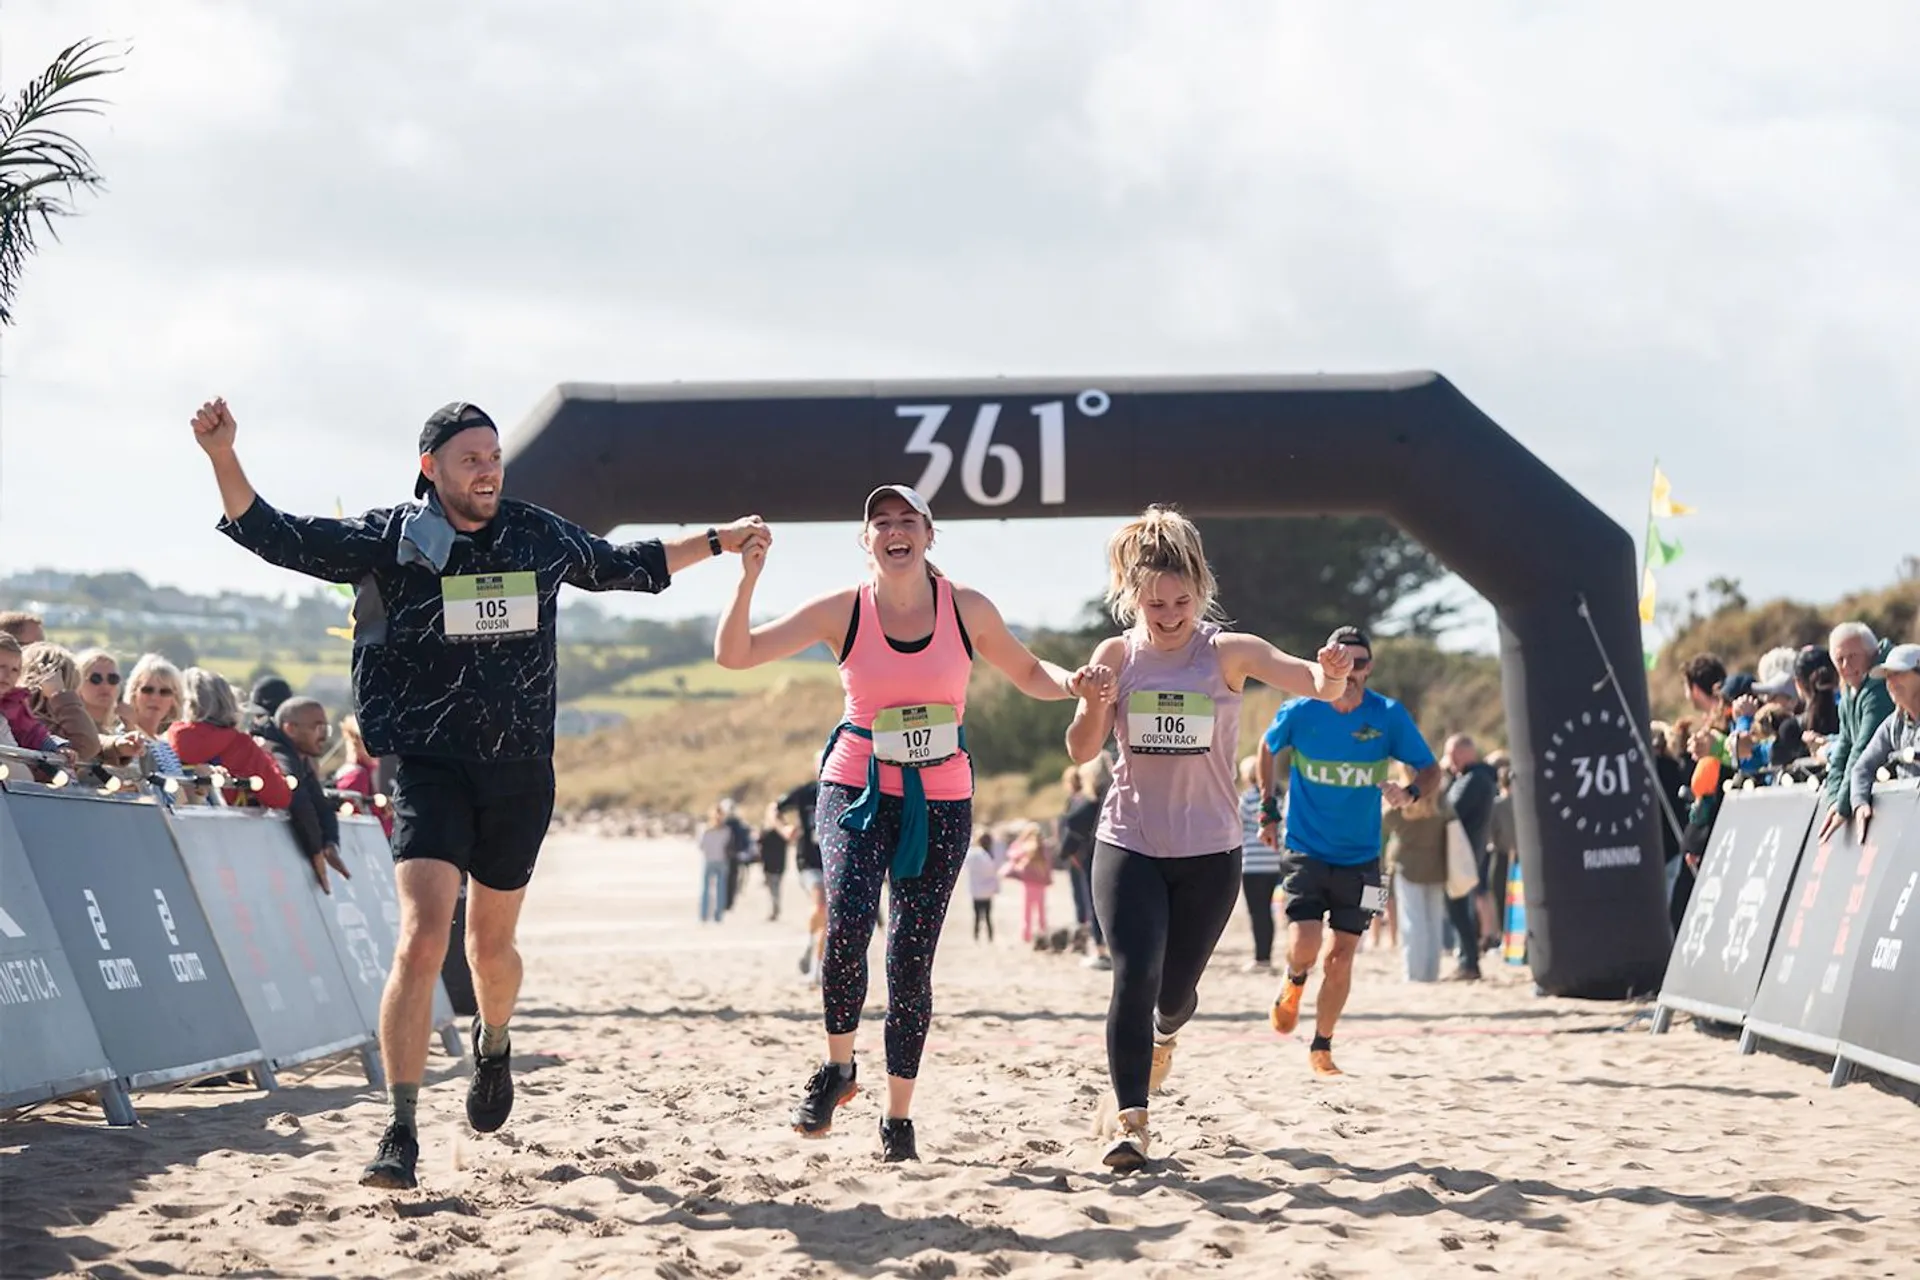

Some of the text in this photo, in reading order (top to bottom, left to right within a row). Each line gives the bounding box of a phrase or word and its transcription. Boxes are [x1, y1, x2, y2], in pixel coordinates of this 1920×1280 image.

[475, 600, 508, 619] 105
[475, 619, 510, 631] COUSIN
[1154, 716, 1186, 734] 106
[902, 728, 932, 748] 107
[1141, 733, 1198, 745] COUSIN RACH
[909, 747, 931, 759] PELO
[1570, 747, 1639, 799] 361°
[1583, 845, 1642, 870] RUNNING
